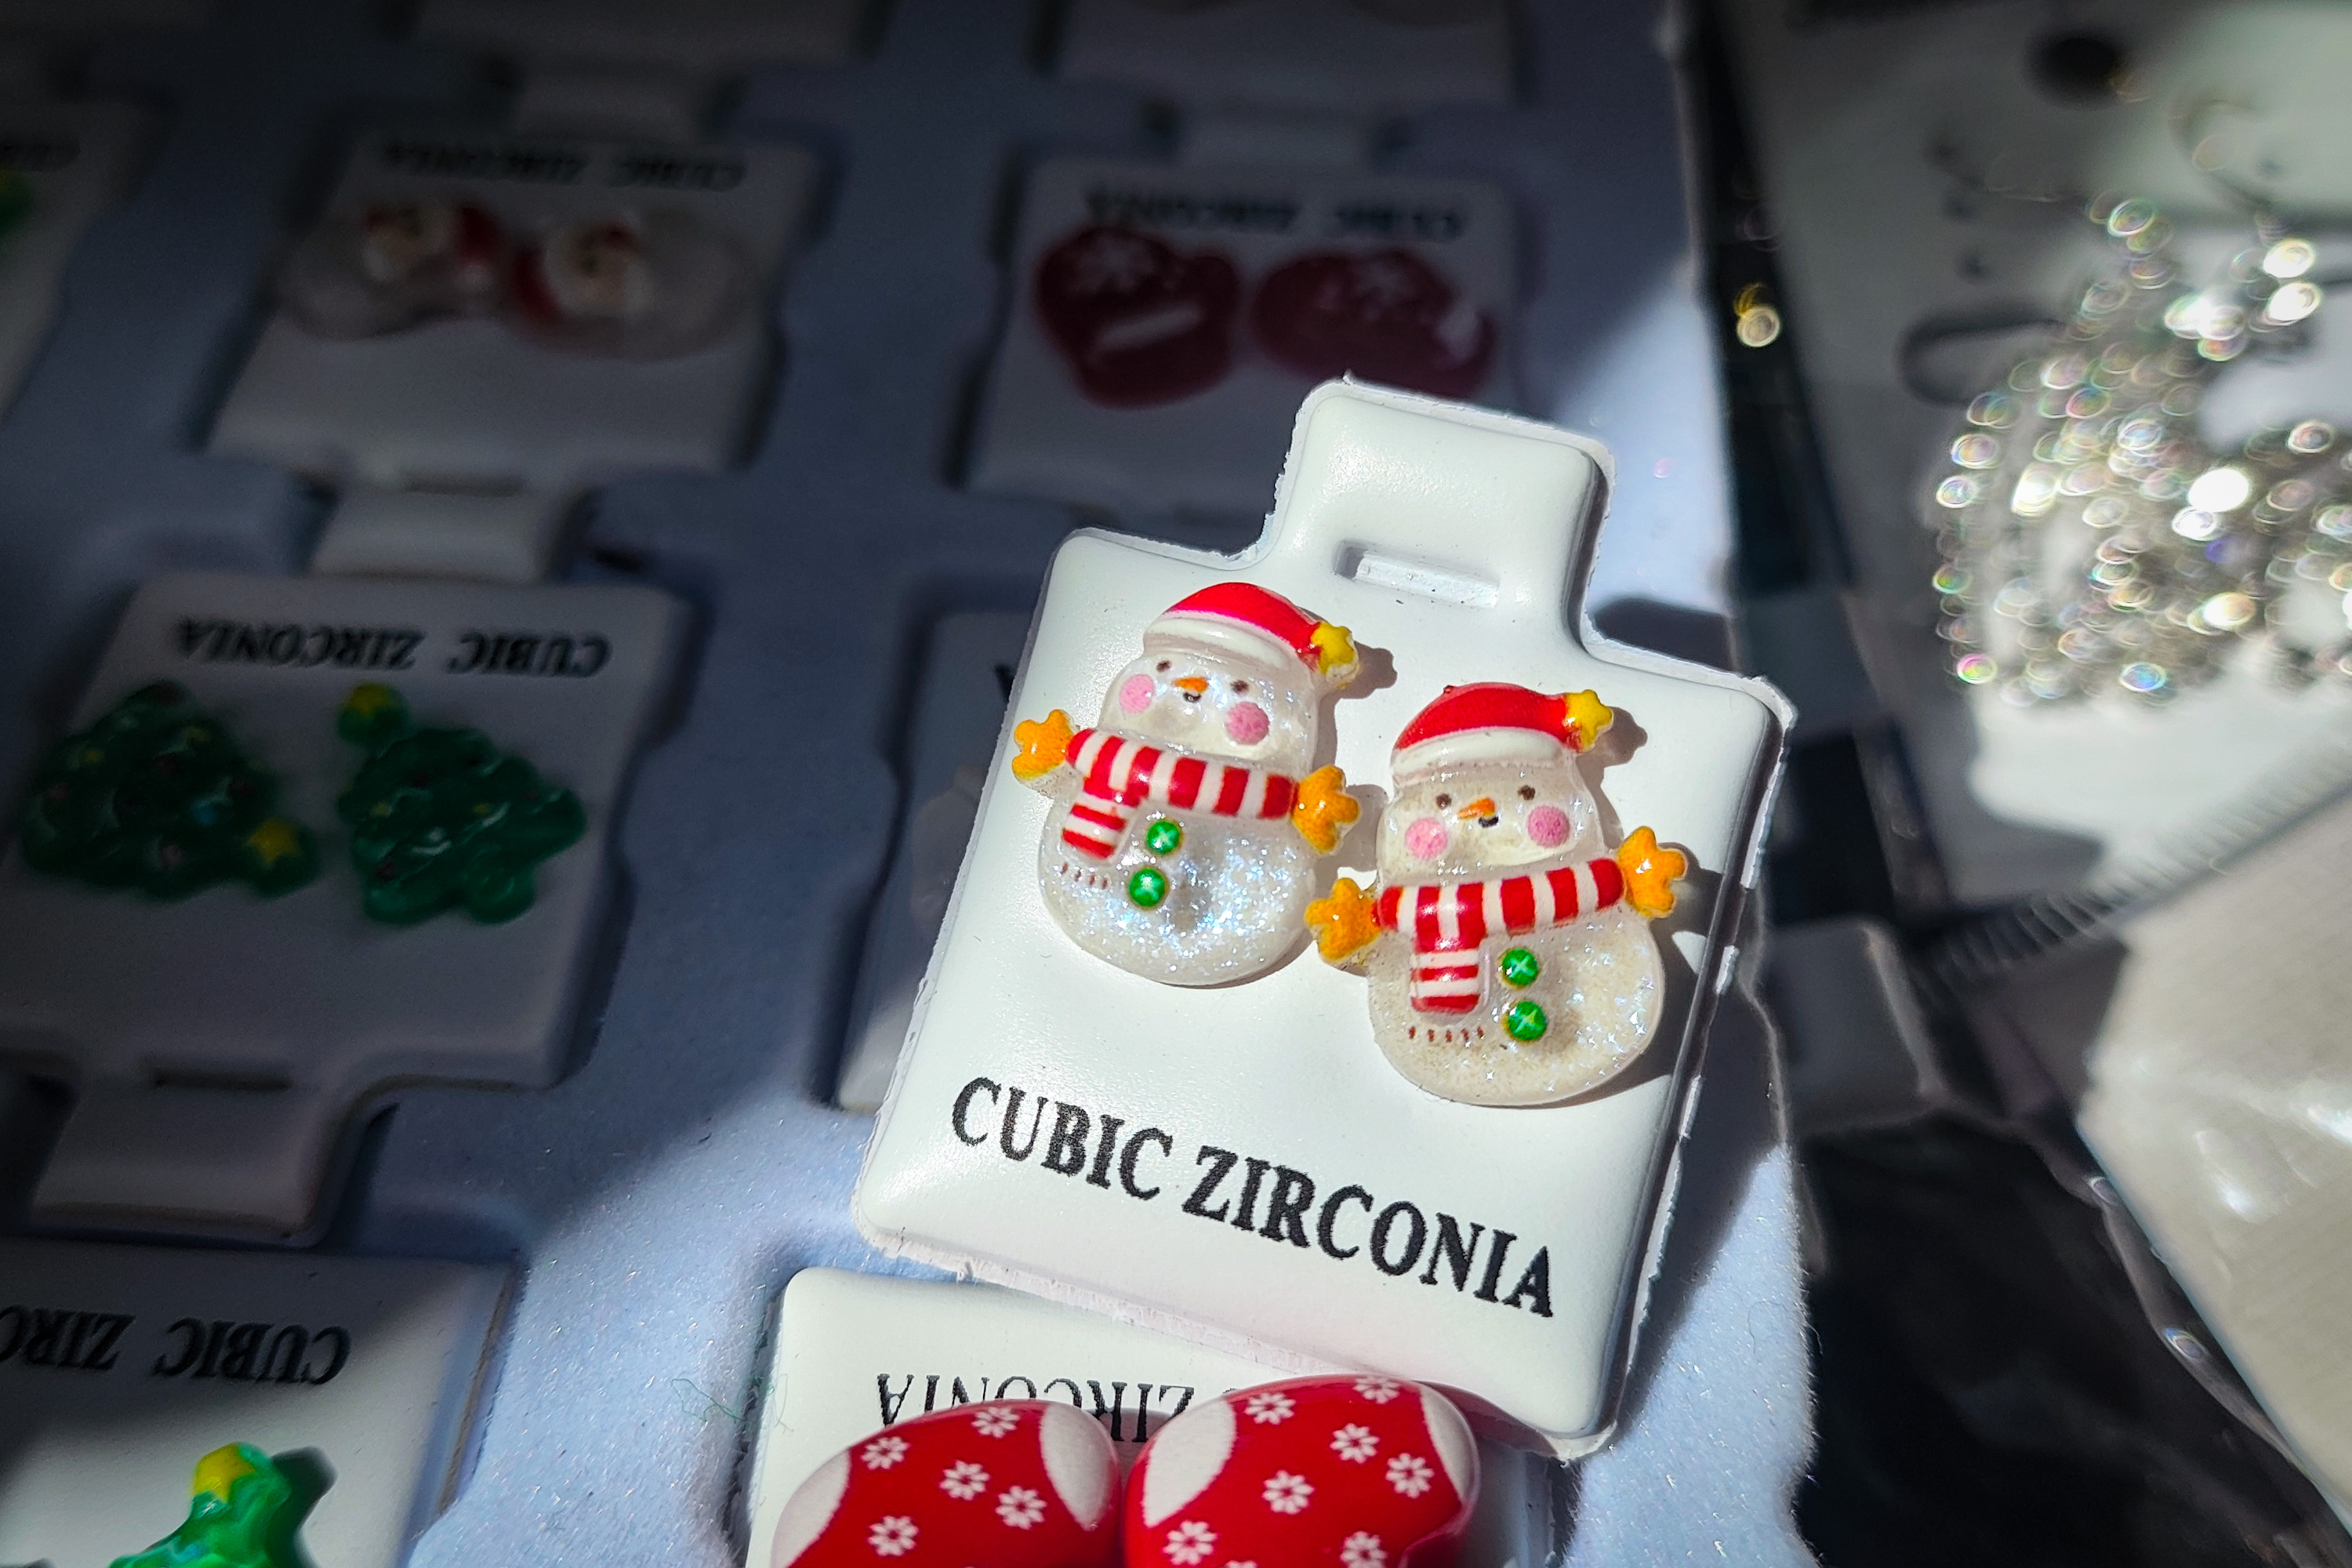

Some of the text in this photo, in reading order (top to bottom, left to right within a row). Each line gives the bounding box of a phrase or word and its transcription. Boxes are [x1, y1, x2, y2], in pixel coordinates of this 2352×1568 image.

[177, 616, 612, 677] CUBIC ZIRCONIA
[950, 1076, 1555, 1319] CUBIC ZIRCONIA
[154, 1316, 351, 1385] CUBIC
